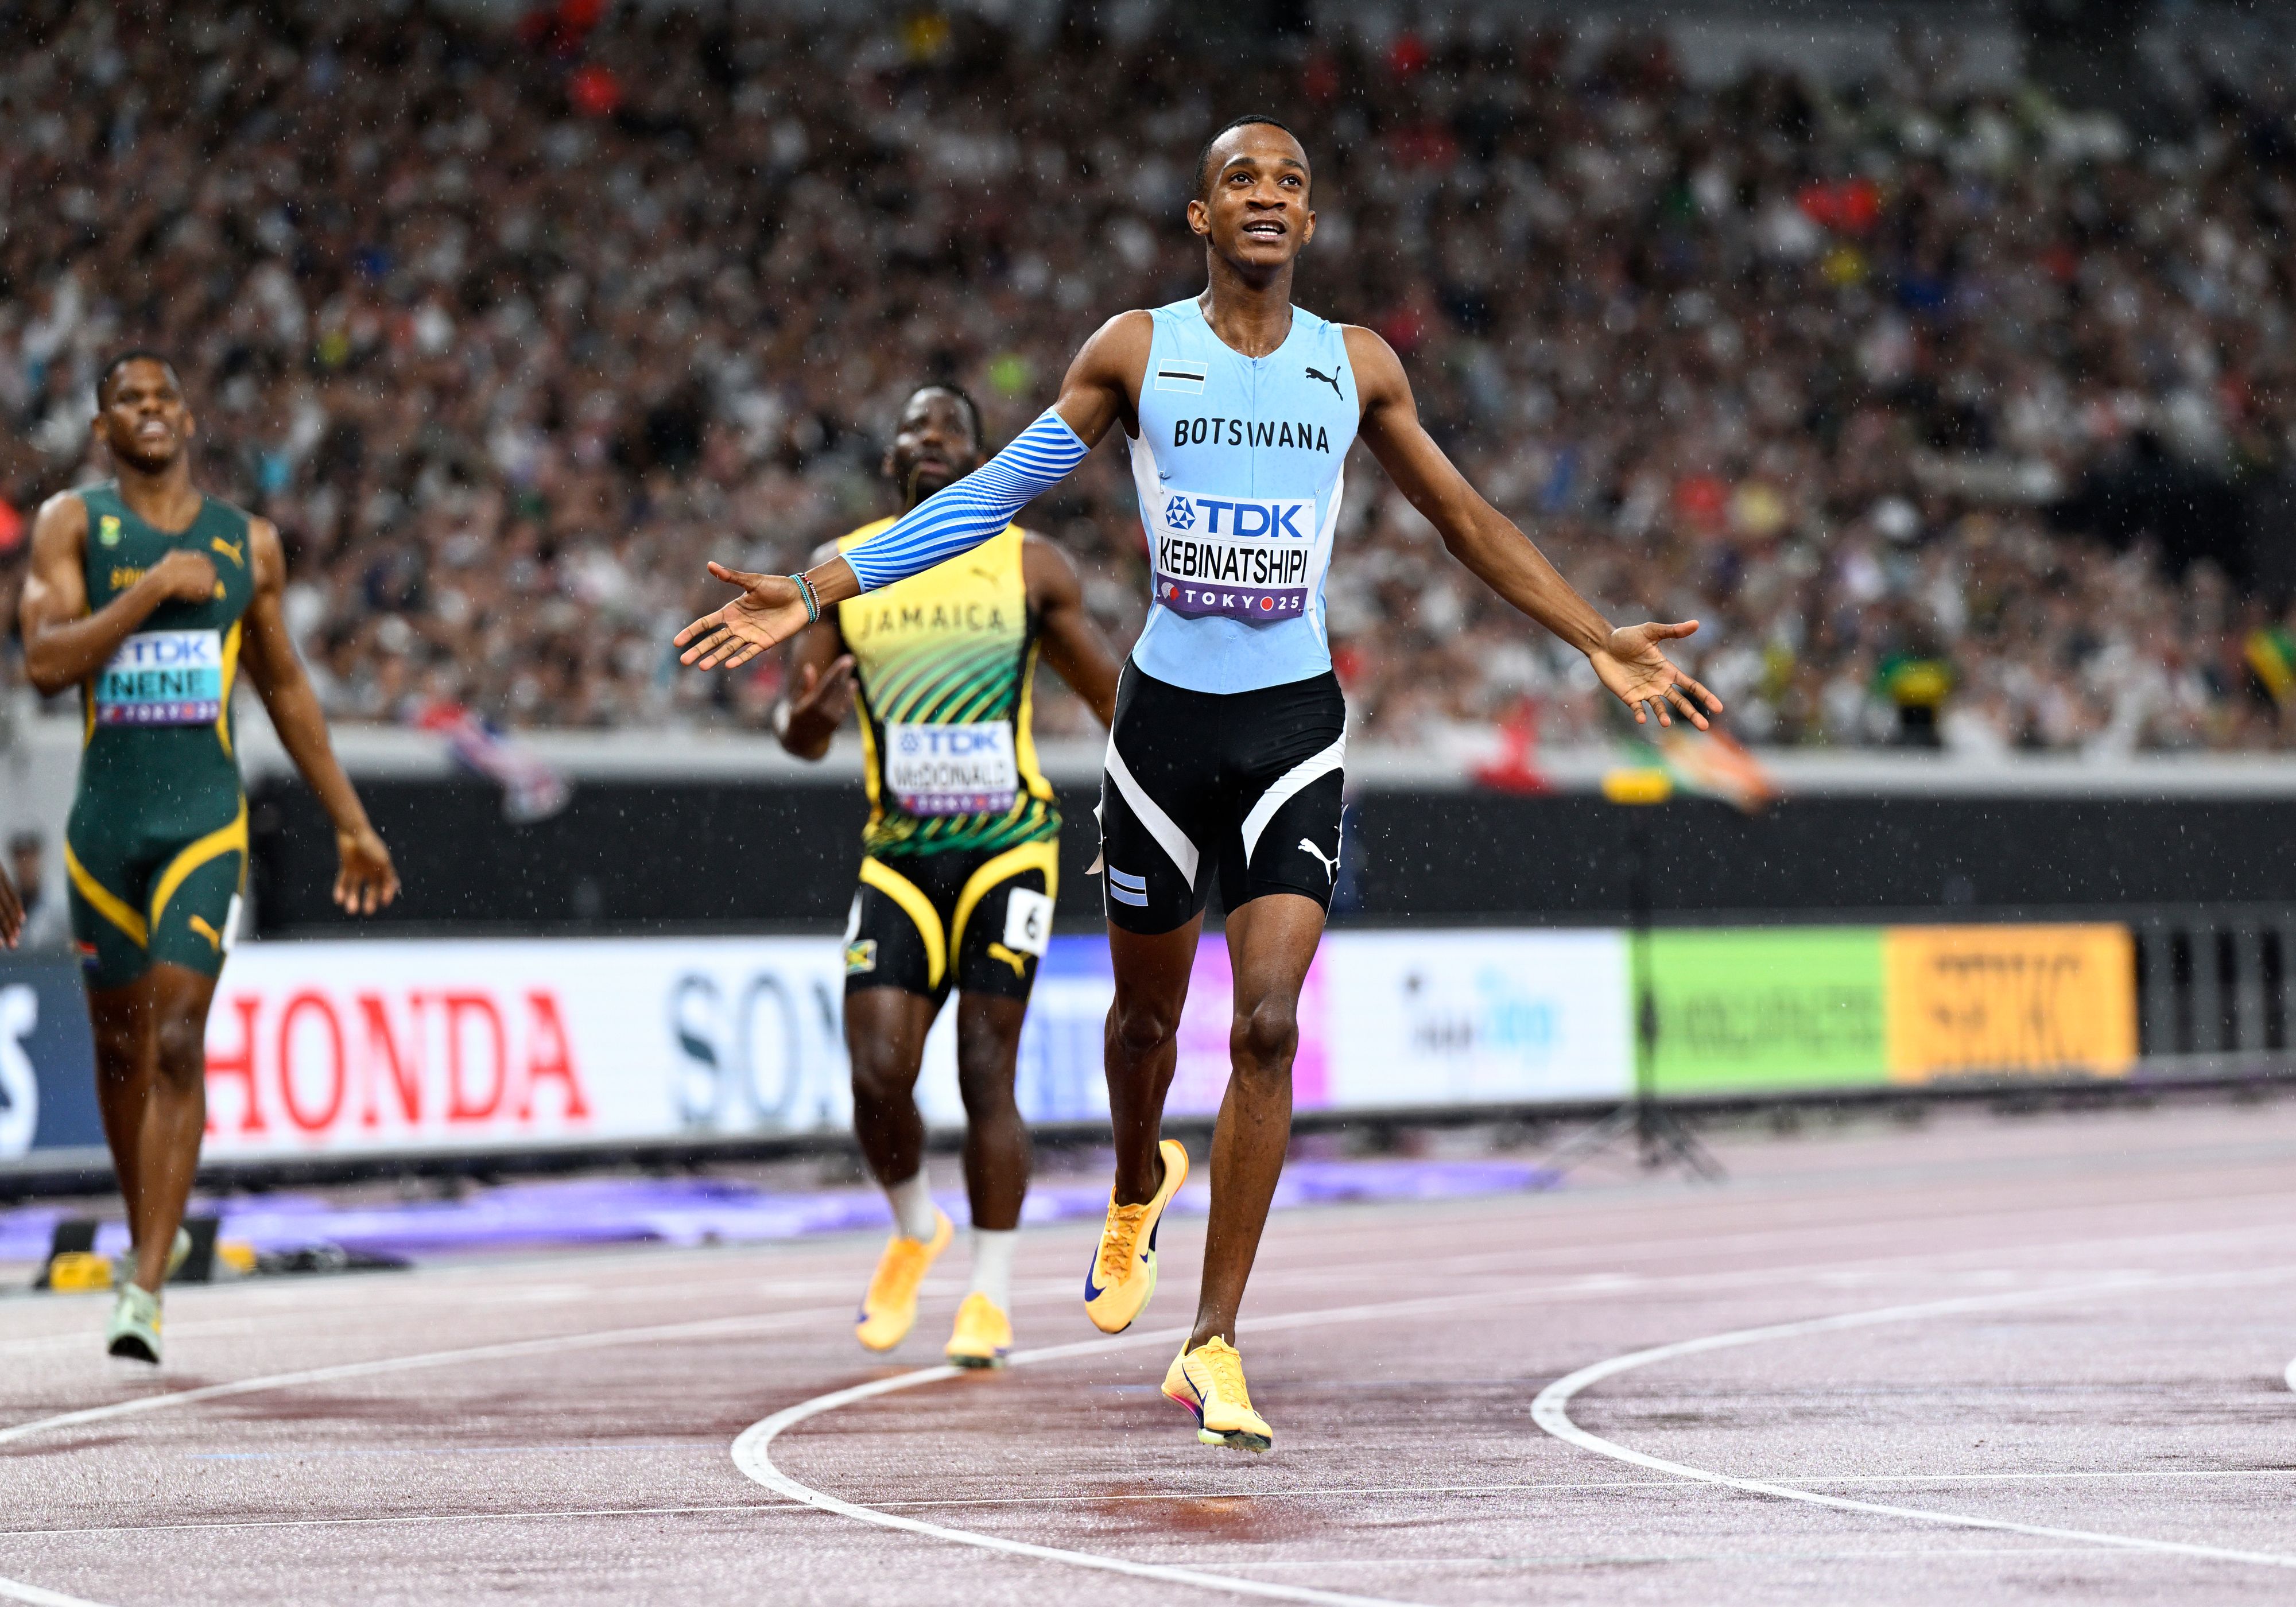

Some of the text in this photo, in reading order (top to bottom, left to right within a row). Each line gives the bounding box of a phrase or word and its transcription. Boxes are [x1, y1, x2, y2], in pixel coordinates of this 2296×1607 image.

[1174, 417, 1329, 454] BOTSWANA
[1196, 499, 1303, 538] TDK
[1159, 535, 1308, 584] KEBINATSHIPI
[860, 600, 1009, 641] JAMAICA
[127, 637, 208, 663] TDK
[110, 668, 203, 697] NENE
[922, 728, 1000, 756] TDK
[1024, 905, 1042, 941] 6
[205, 988, 590, 1135] HONDA
